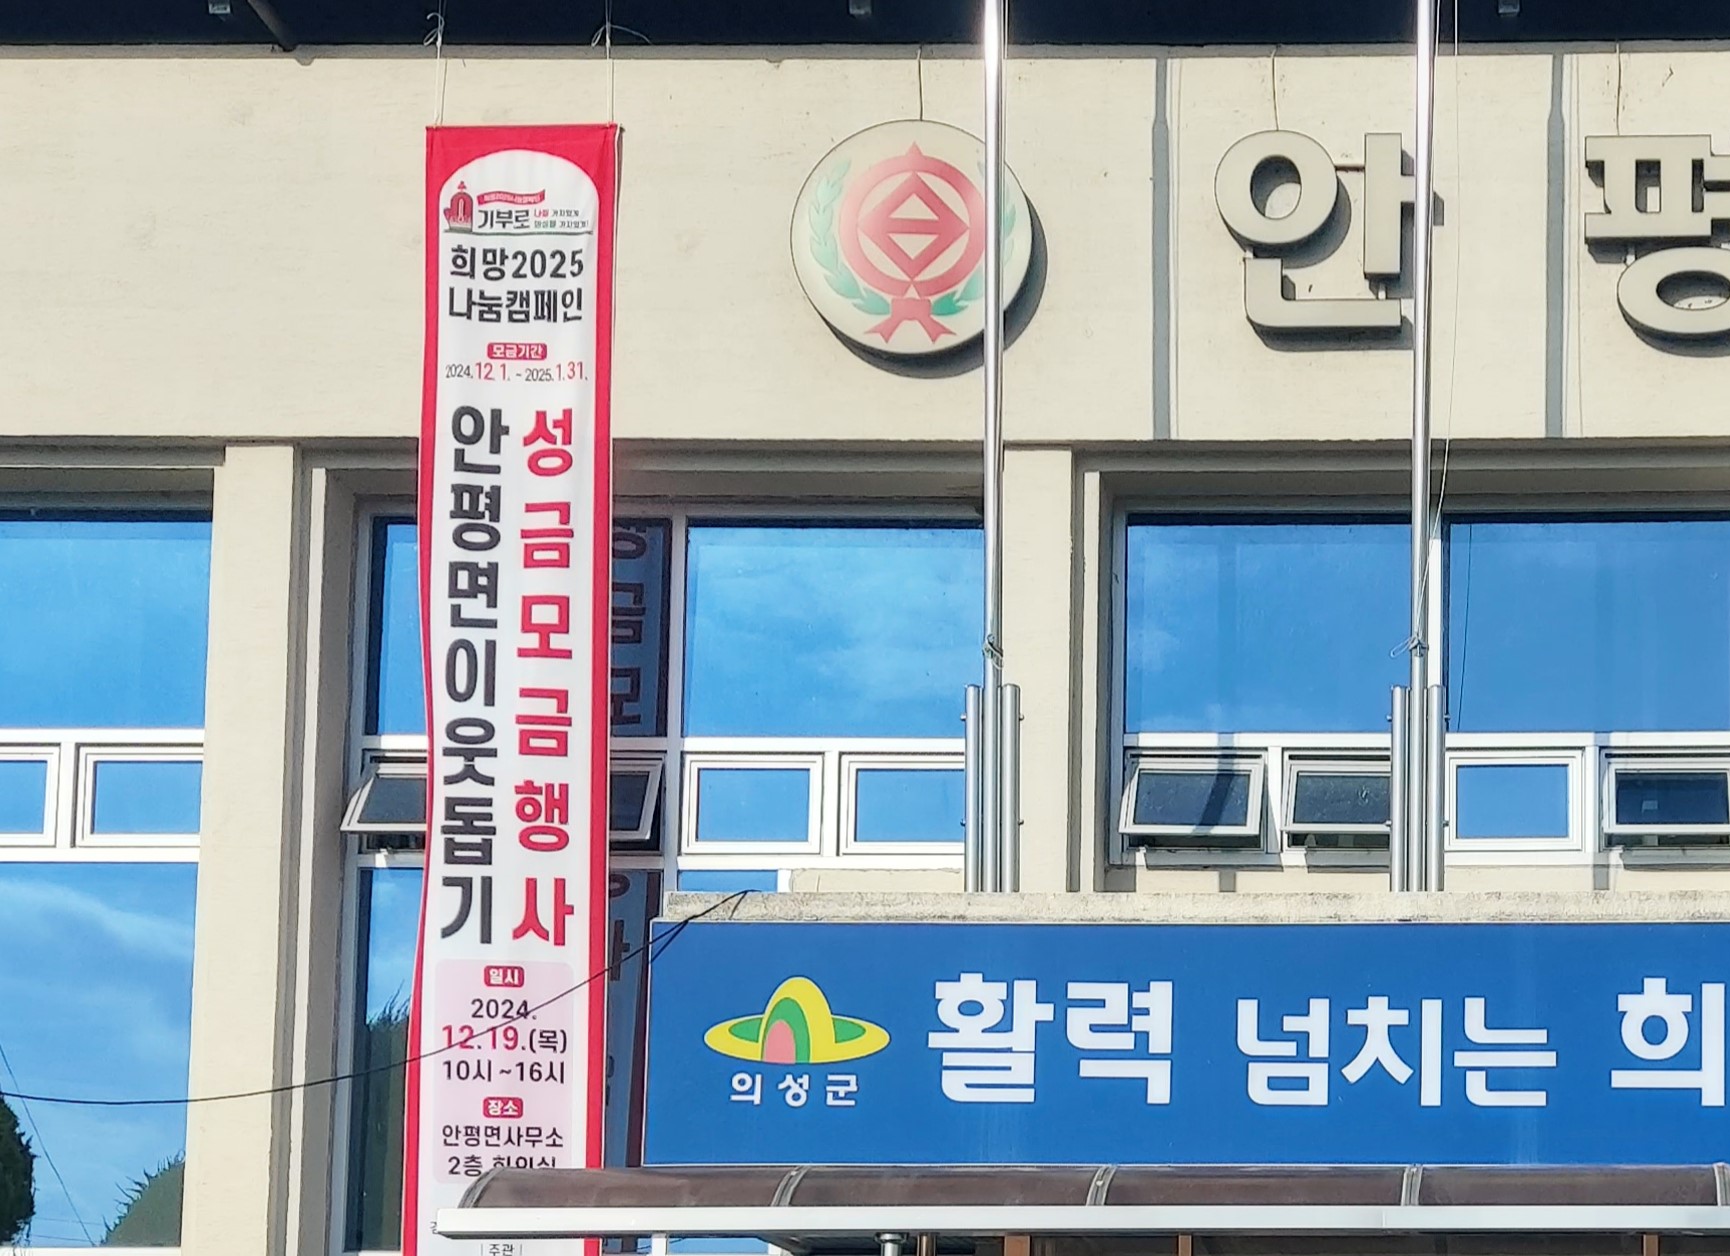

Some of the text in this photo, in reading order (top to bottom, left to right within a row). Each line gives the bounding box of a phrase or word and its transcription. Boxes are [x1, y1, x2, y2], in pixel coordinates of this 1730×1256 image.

[478, 208, 530, 230] 기부로
[449, 245, 584, 281] 희망2025
[448, 287, 582, 323] 나눔캠페인
[492, 344, 543, 359] 모금기간
[488, 967, 519, 985] 일시
[471, 998, 537, 1020] 2024.
[927, 972, 1175, 1105] 활력
[1236, 995, 1557, 1107] 넘치는
[730, 1072, 858, 1107] 의성군
[487, 1099, 518, 1116] 장소
[442, 1124, 564, 1148] 안평면사무소
[447, 1155, 483, 1177] 2층
[488, 1243, 515, 1256] 주관
